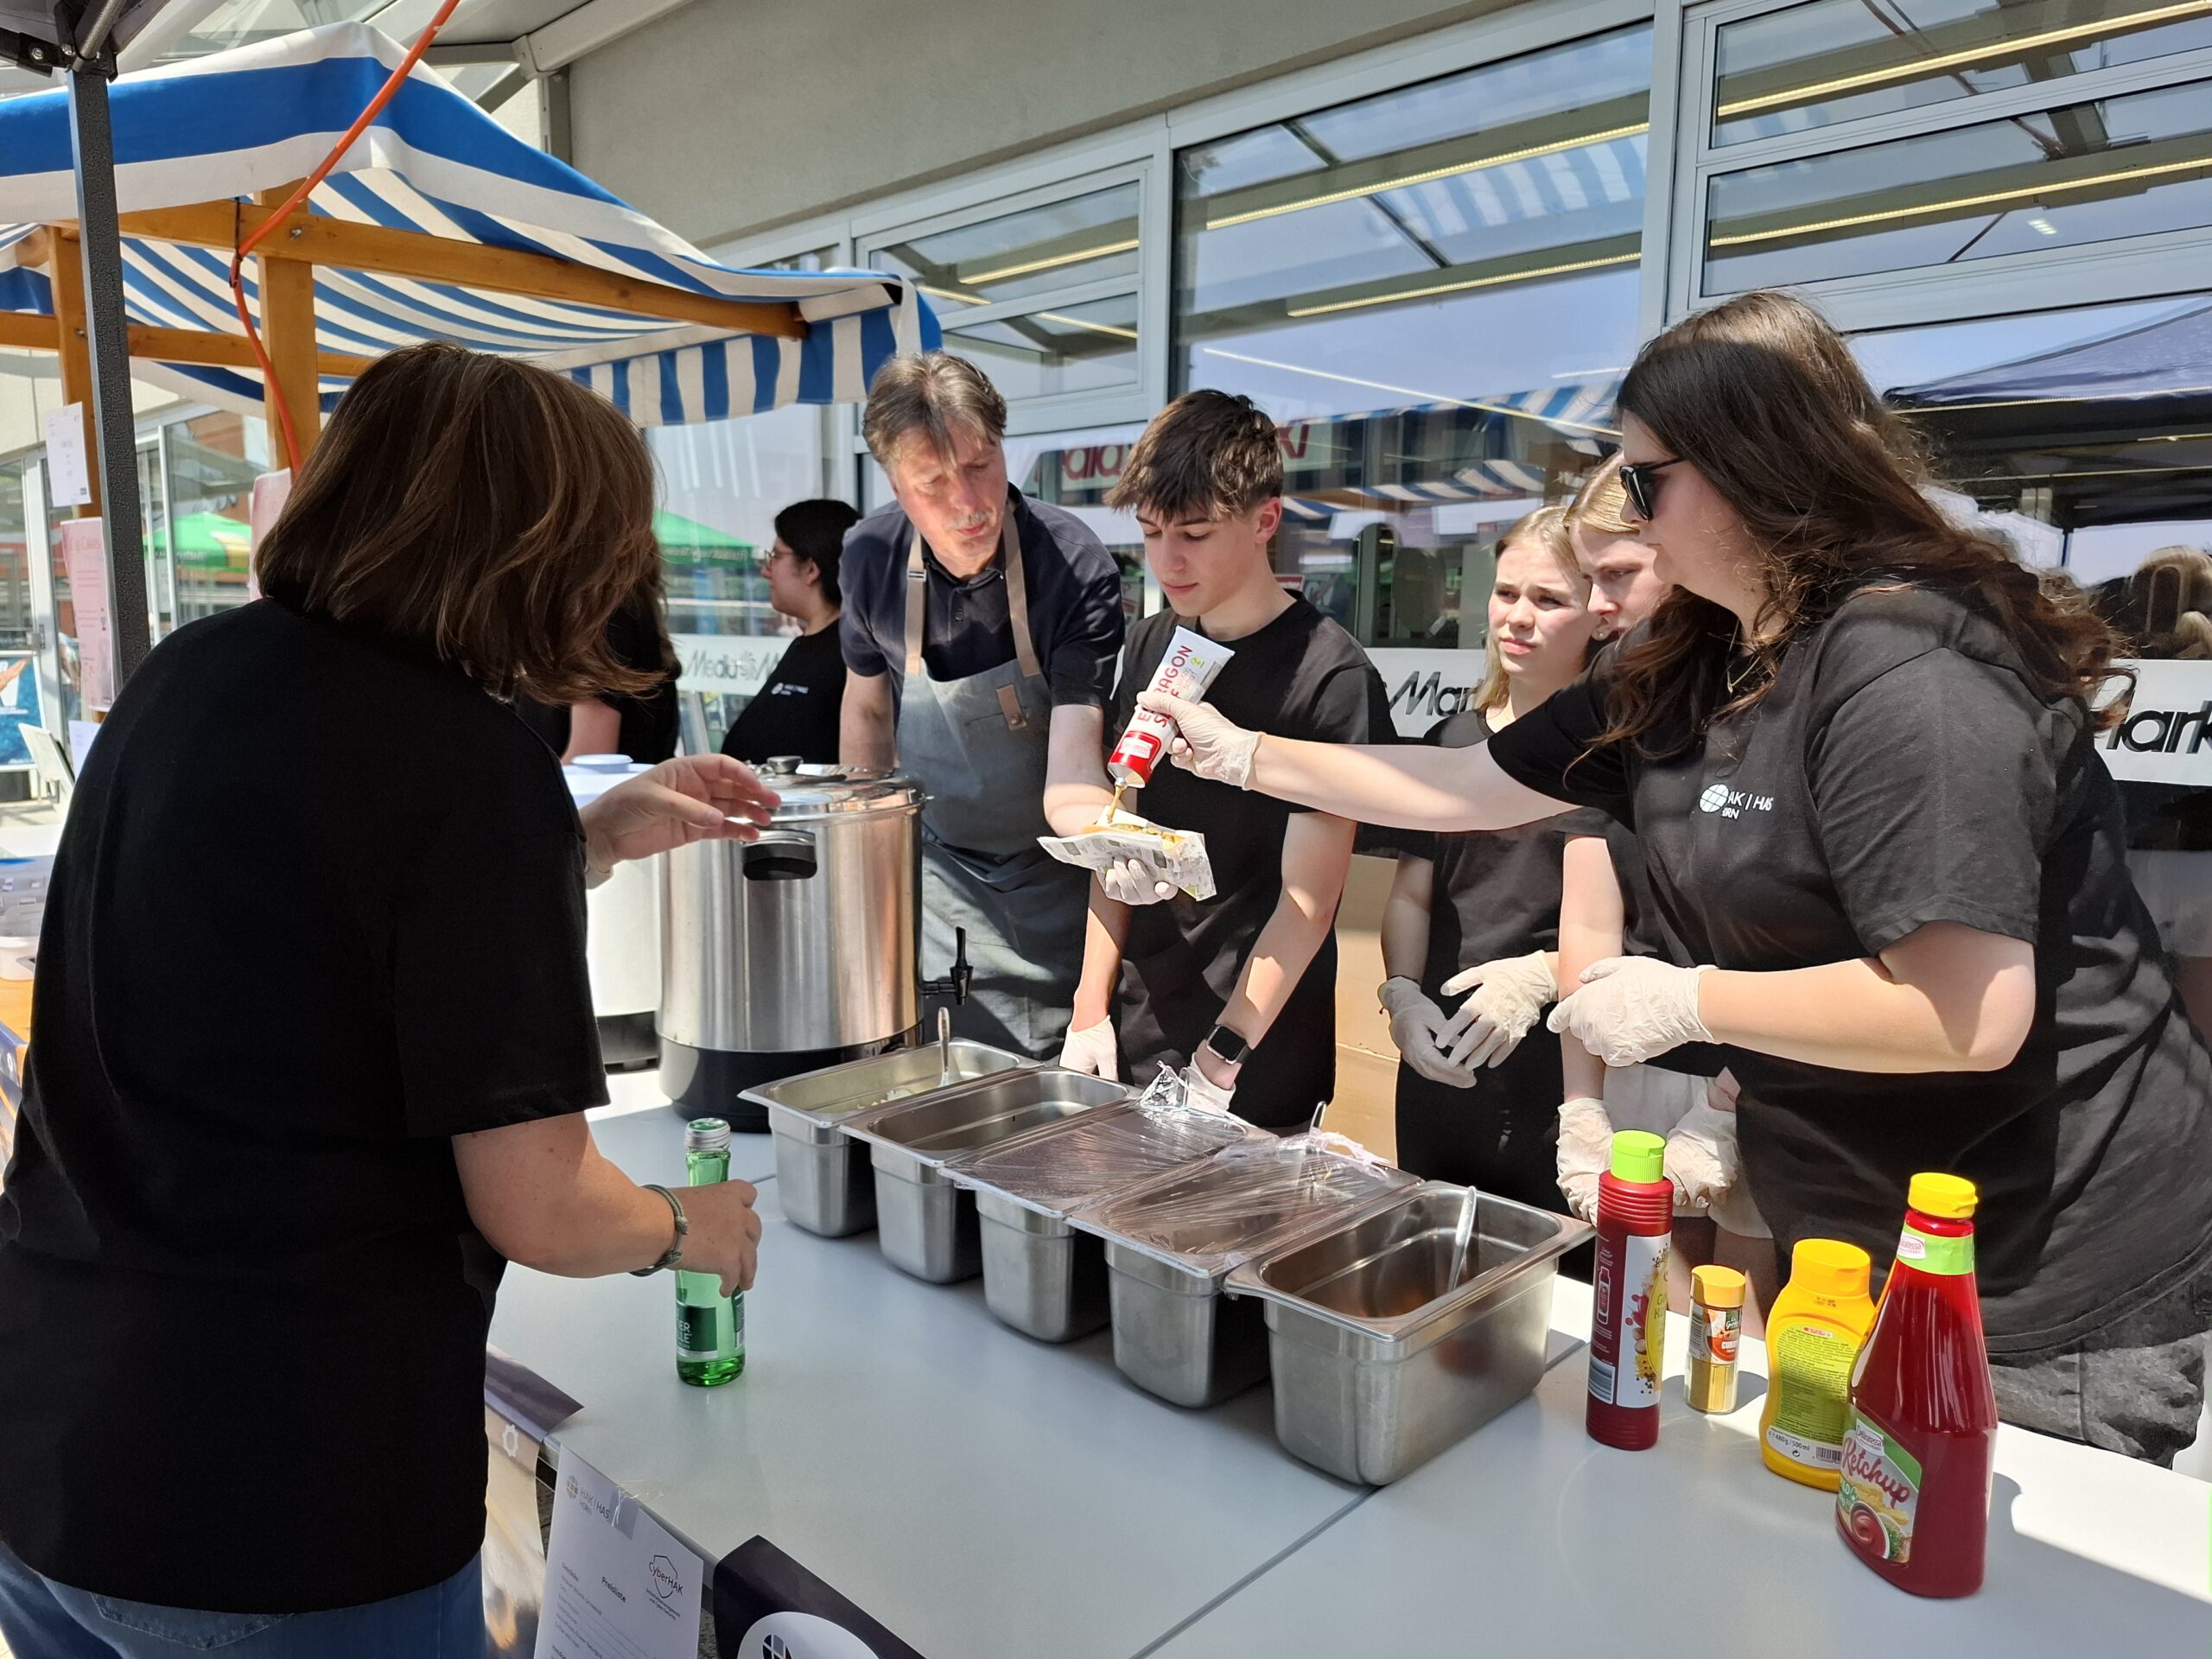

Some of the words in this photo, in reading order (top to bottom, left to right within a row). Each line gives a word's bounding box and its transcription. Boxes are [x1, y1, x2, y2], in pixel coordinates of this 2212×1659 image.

[685, 650, 738, 679] Media
[1389, 671, 1479, 716] Mar
[1728, 791, 1746, 806] AK
[1841, 1436, 1910, 1510] Ketchup
[596, 1502, 610, 1520] HAS
[601, 1576, 626, 1603] Preisliste
[648, 1561, 684, 1596] CyberHAK
